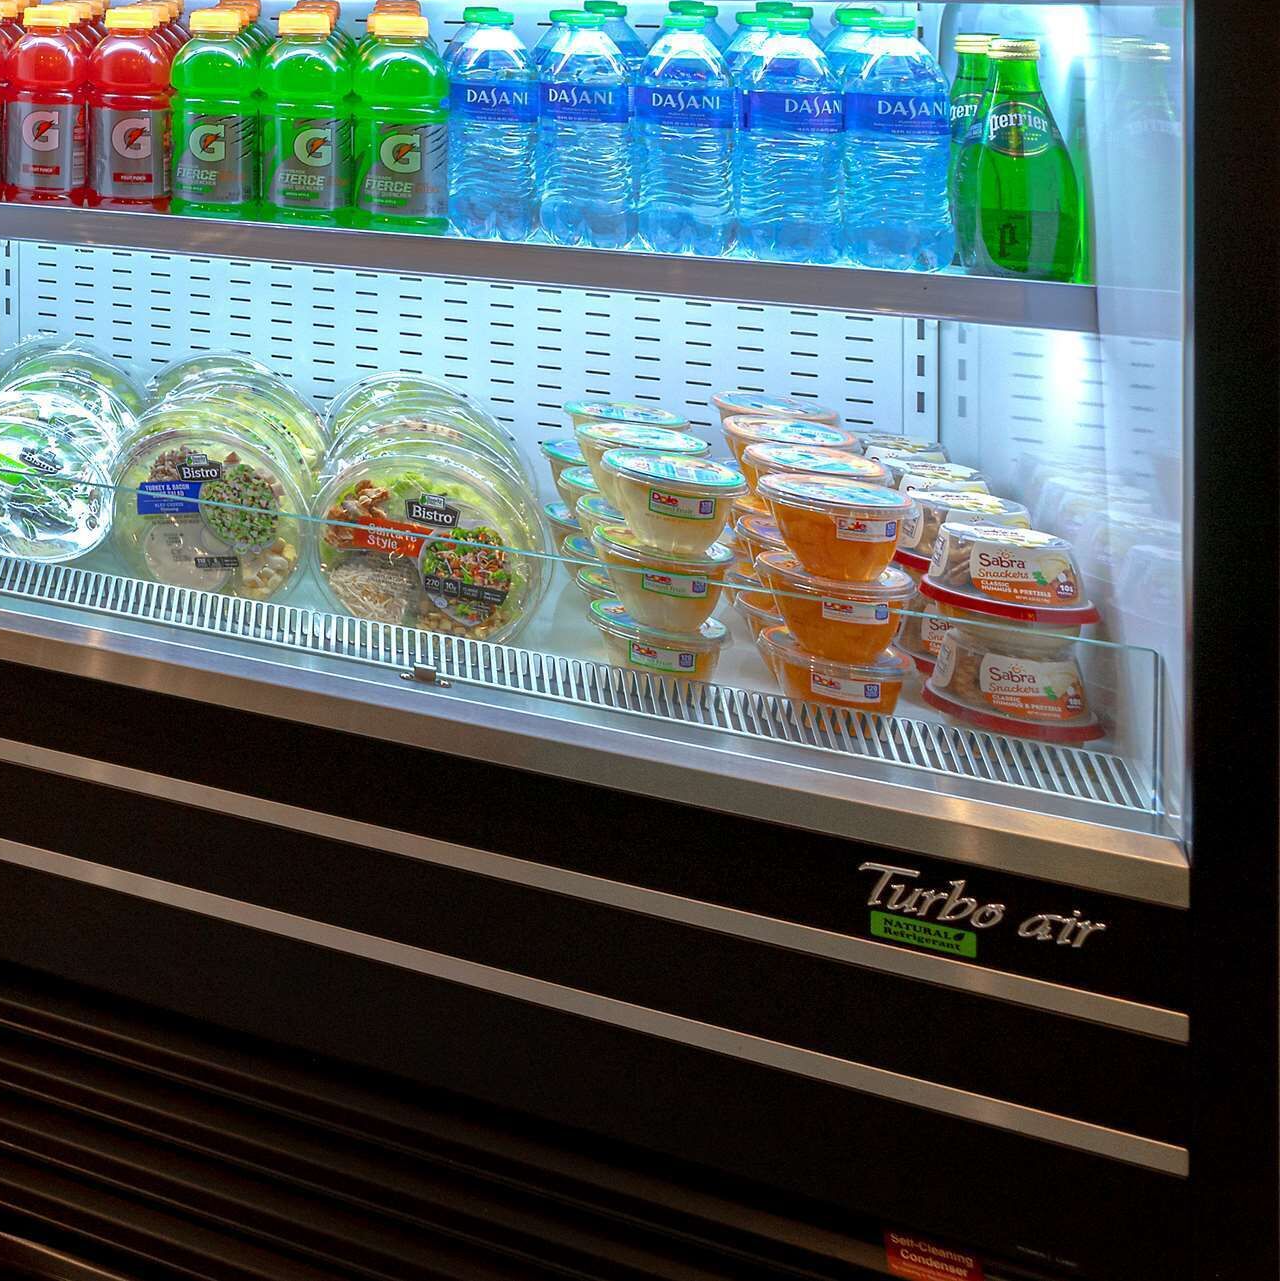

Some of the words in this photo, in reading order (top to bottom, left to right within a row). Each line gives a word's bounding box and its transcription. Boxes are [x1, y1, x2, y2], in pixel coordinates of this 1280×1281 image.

[466, 87, 528, 107] DASANI
[548, 86, 613, 107] DASANI
[651, 91, 720, 110] DASANI
[877, 97, 947, 118] DASANI
[22, 111, 60, 151] G
[989, 111, 1047, 140] perrier
[111, 117, 152, 159] G
[189, 124, 226, 162] G
[294, 128, 332, 167] G
[380, 134, 421, 173] G
[176, 168, 217, 180] FIERCE
[279, 173, 325, 186] FIERCE
[365, 179, 414, 193] FIERCE
[183, 467, 218, 479] Bistro
[412, 504, 456, 524] Bistro
[367, 535, 398, 550] Style
[978, 552, 1026, 569] Sabra
[978, 568, 1028, 580] Snackers
[990, 668, 1036, 684] Sabra
[858, 861, 1006, 929] Turbo
[1018, 910, 1107, 947] air
[883, 927, 961, 951] Refrigerant
[884, 917, 952, 940] NATURAL
[890, 1232, 974, 1268] Self-Cleaning
[900, 1248, 968, 1277] Condenser
